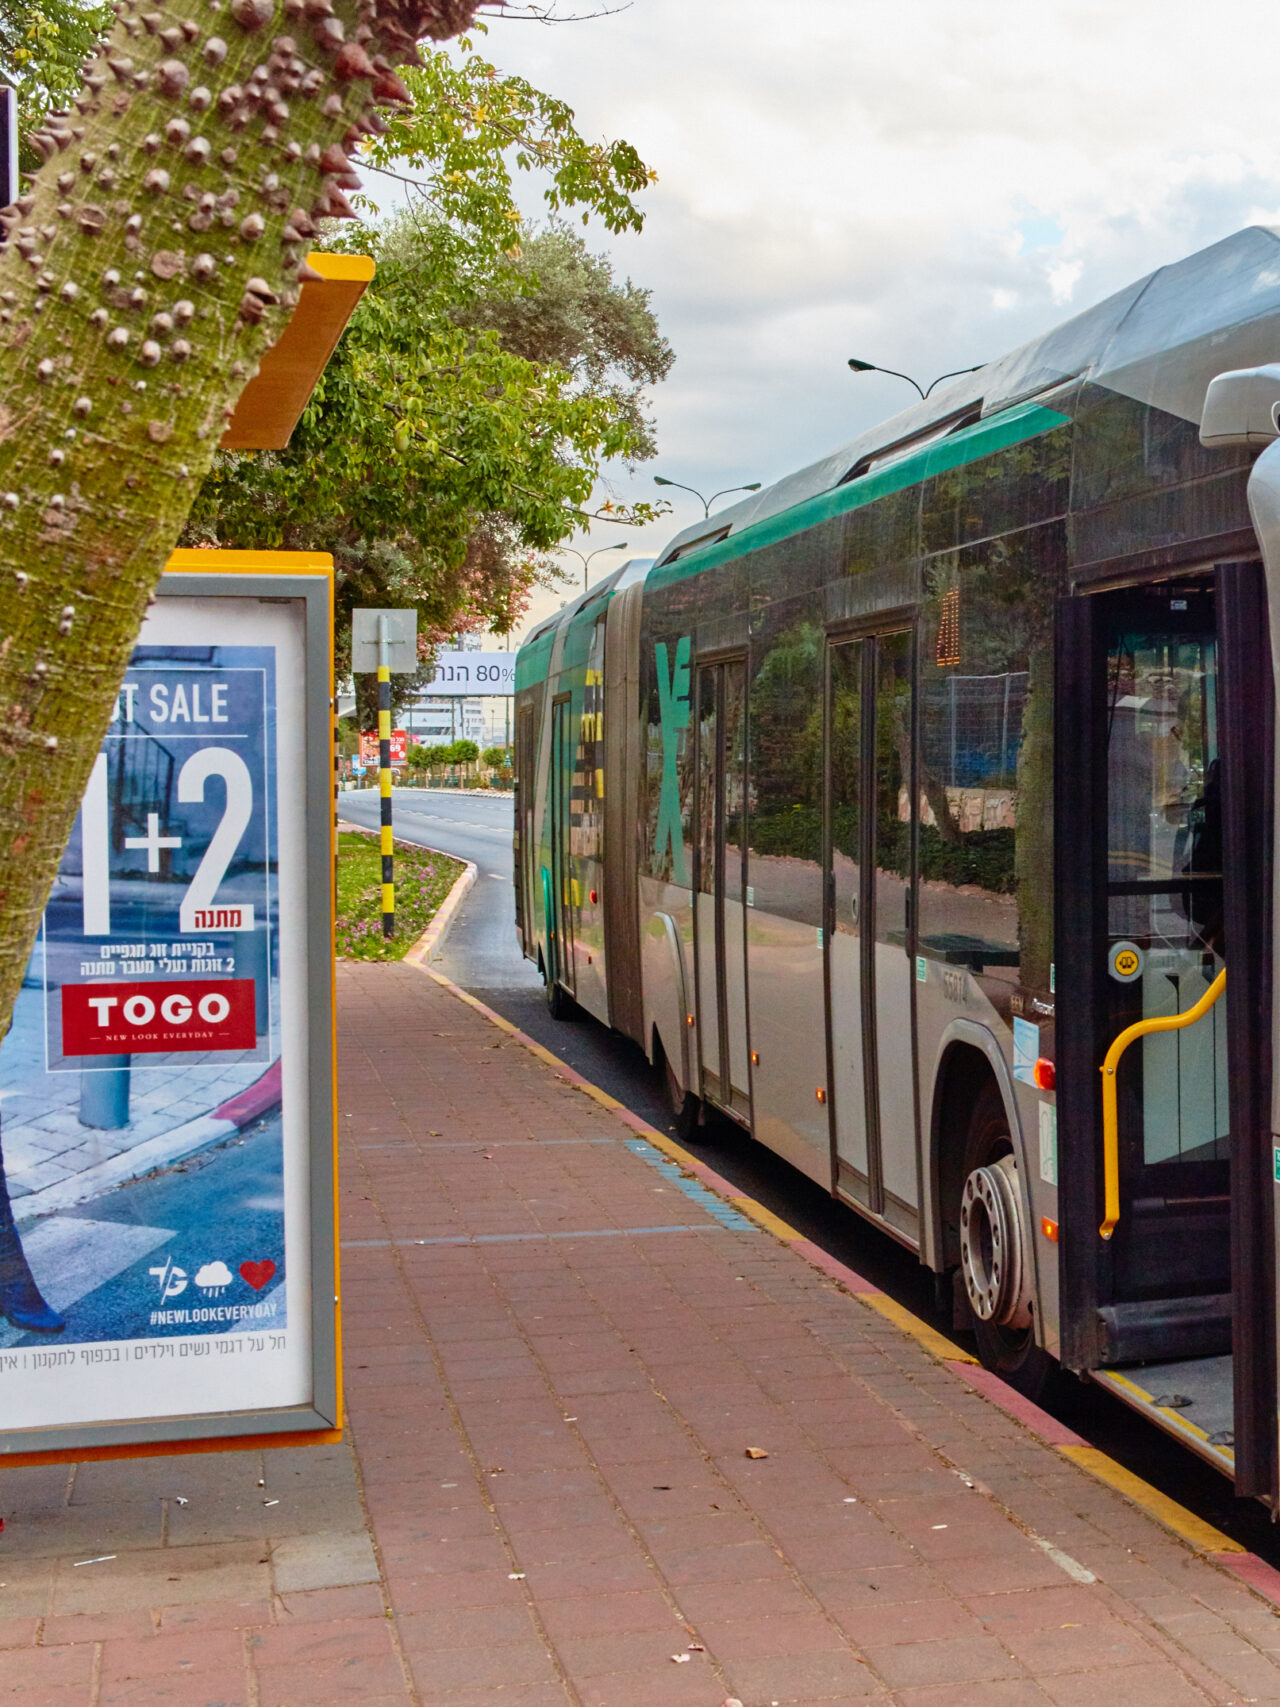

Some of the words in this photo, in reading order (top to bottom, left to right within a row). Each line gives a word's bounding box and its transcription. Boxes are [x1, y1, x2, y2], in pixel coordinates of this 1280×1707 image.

[150, 683, 229, 722] SALE
[194, 909, 242, 929] מתנה
[100, 944, 146, 959] מגפיים
[150, 943, 168, 958] זוג
[171, 942, 216, 959] בקניית
[80, 961, 115, 976] מתנה
[119, 958, 155, 975] מעבר
[159, 958, 187, 973] נעלי
[190, 958, 223, 973] זוגות
[226, 957, 236, 972] 2
[88, 993, 231, 1027] TOGO
[163, 1031, 214, 1040] EVERYDAY
[150, 1304, 277, 1325] #NEWLOOKEVERYDAY
[179, 1342, 210, 1357] נשים
[215, 1340, 242, 1356] דגמי
[247, 1337, 264, 1352] על
[269, 1335, 286, 1350] חל
[81, 1348, 120, 1366] בכפוף
[134, 1343, 174, 1360] וילדים
[32, 1349, 75, 1370] לתקנון
